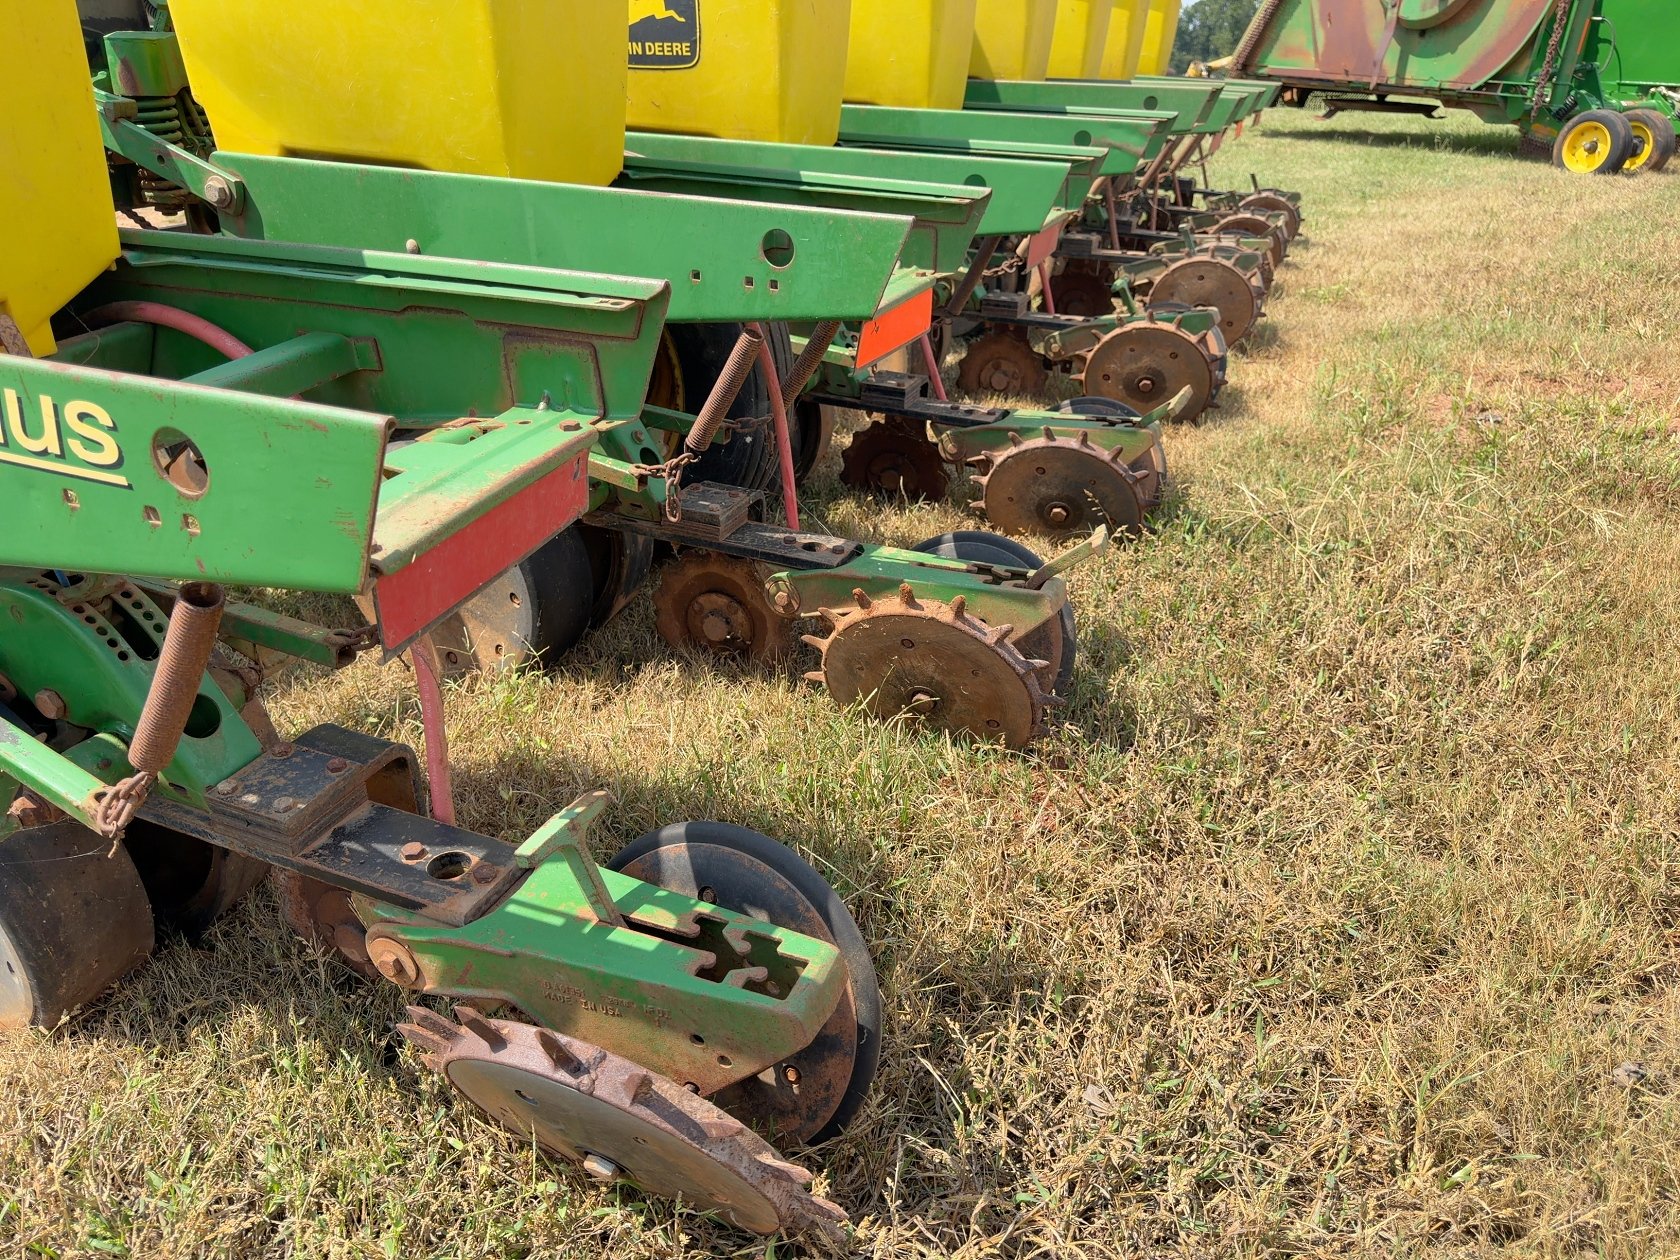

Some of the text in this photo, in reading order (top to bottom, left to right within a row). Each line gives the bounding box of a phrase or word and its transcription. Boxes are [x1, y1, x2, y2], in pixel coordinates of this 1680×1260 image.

[645, 41, 691, 56] DEERE
[0, 387, 121, 466] us
[543, 990, 573, 1006] MADE
[580, 999, 598, 1013] IN
[600, 1003, 623, 1018] USA
